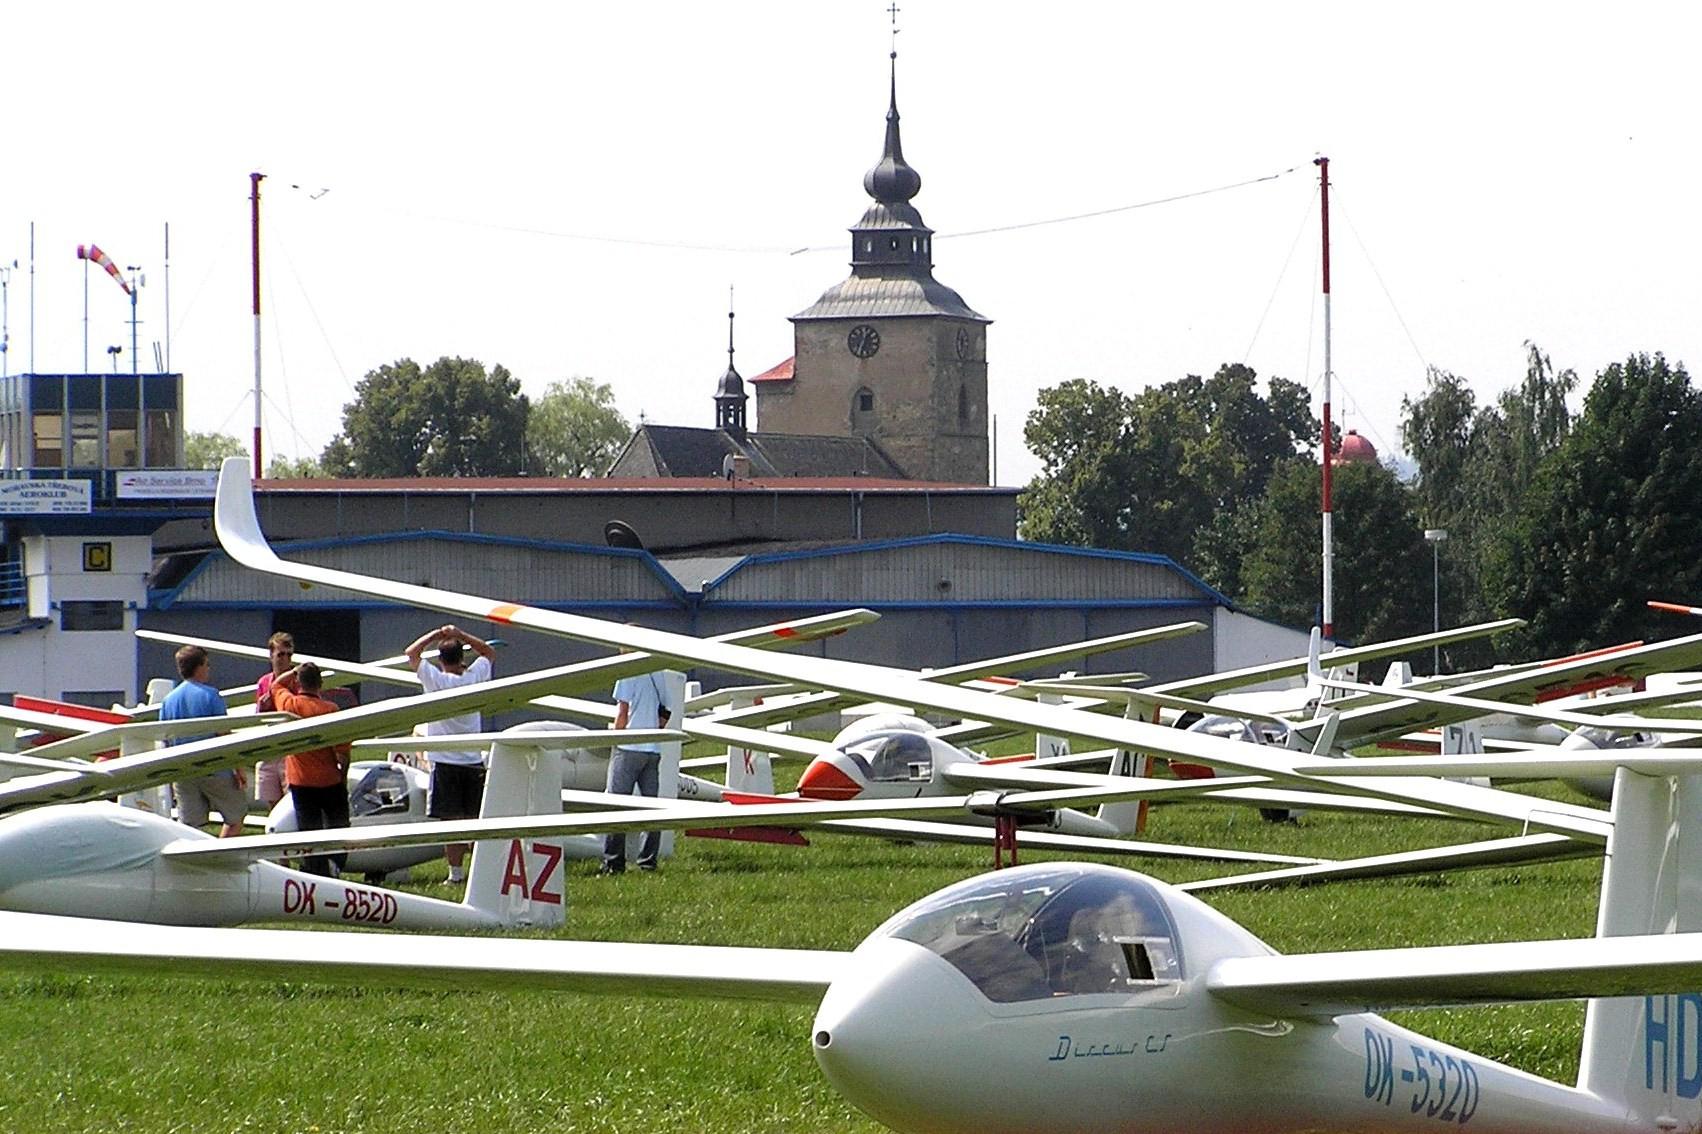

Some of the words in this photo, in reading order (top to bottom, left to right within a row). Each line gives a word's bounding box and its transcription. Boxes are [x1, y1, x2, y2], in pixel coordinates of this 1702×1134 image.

[20, 490, 68, 498] AEROKLUB
[89, 546, 105, 567] C
[501, 839, 562, 905] AZ
[1645, 994, 1702, 1099] HD
